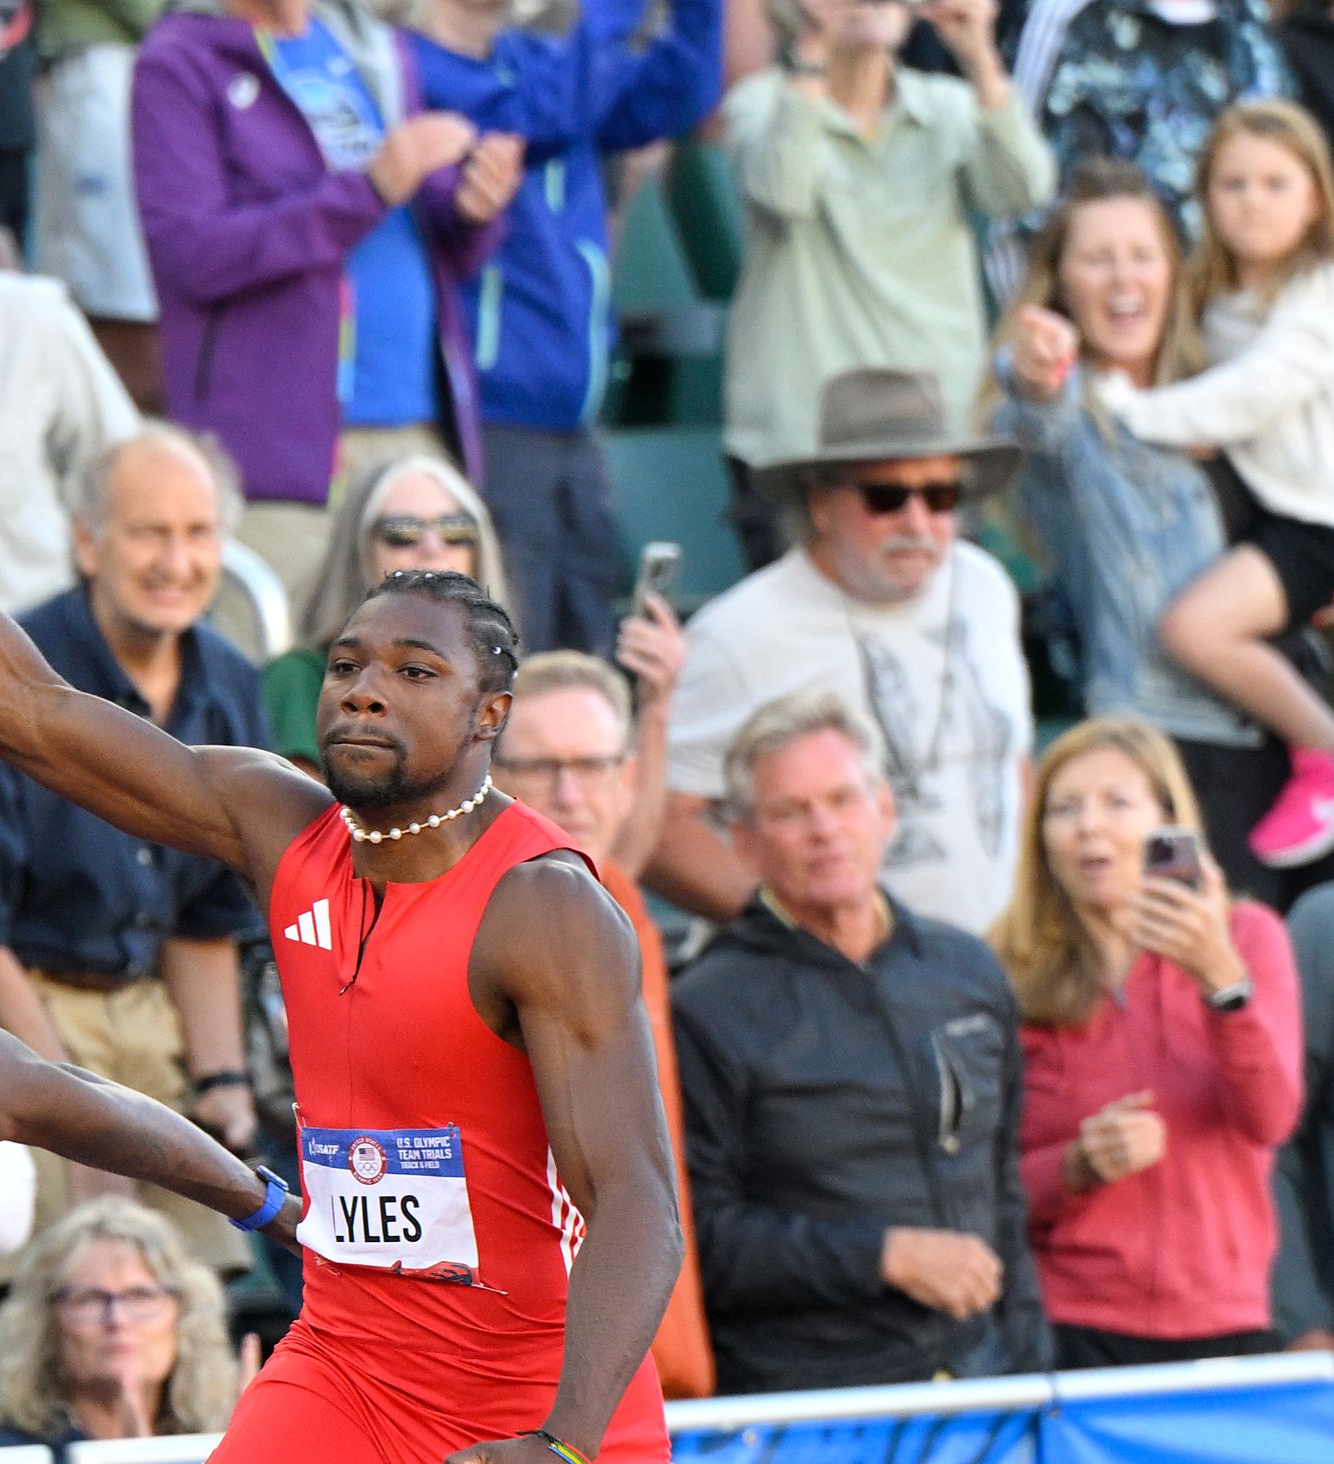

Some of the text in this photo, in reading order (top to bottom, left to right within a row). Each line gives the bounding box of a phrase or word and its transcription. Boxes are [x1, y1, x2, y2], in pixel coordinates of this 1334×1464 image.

[397, 1136, 451, 1149] U.S. OLYMPIC
[398, 1149, 452, 1160] TEAM TRIALS
